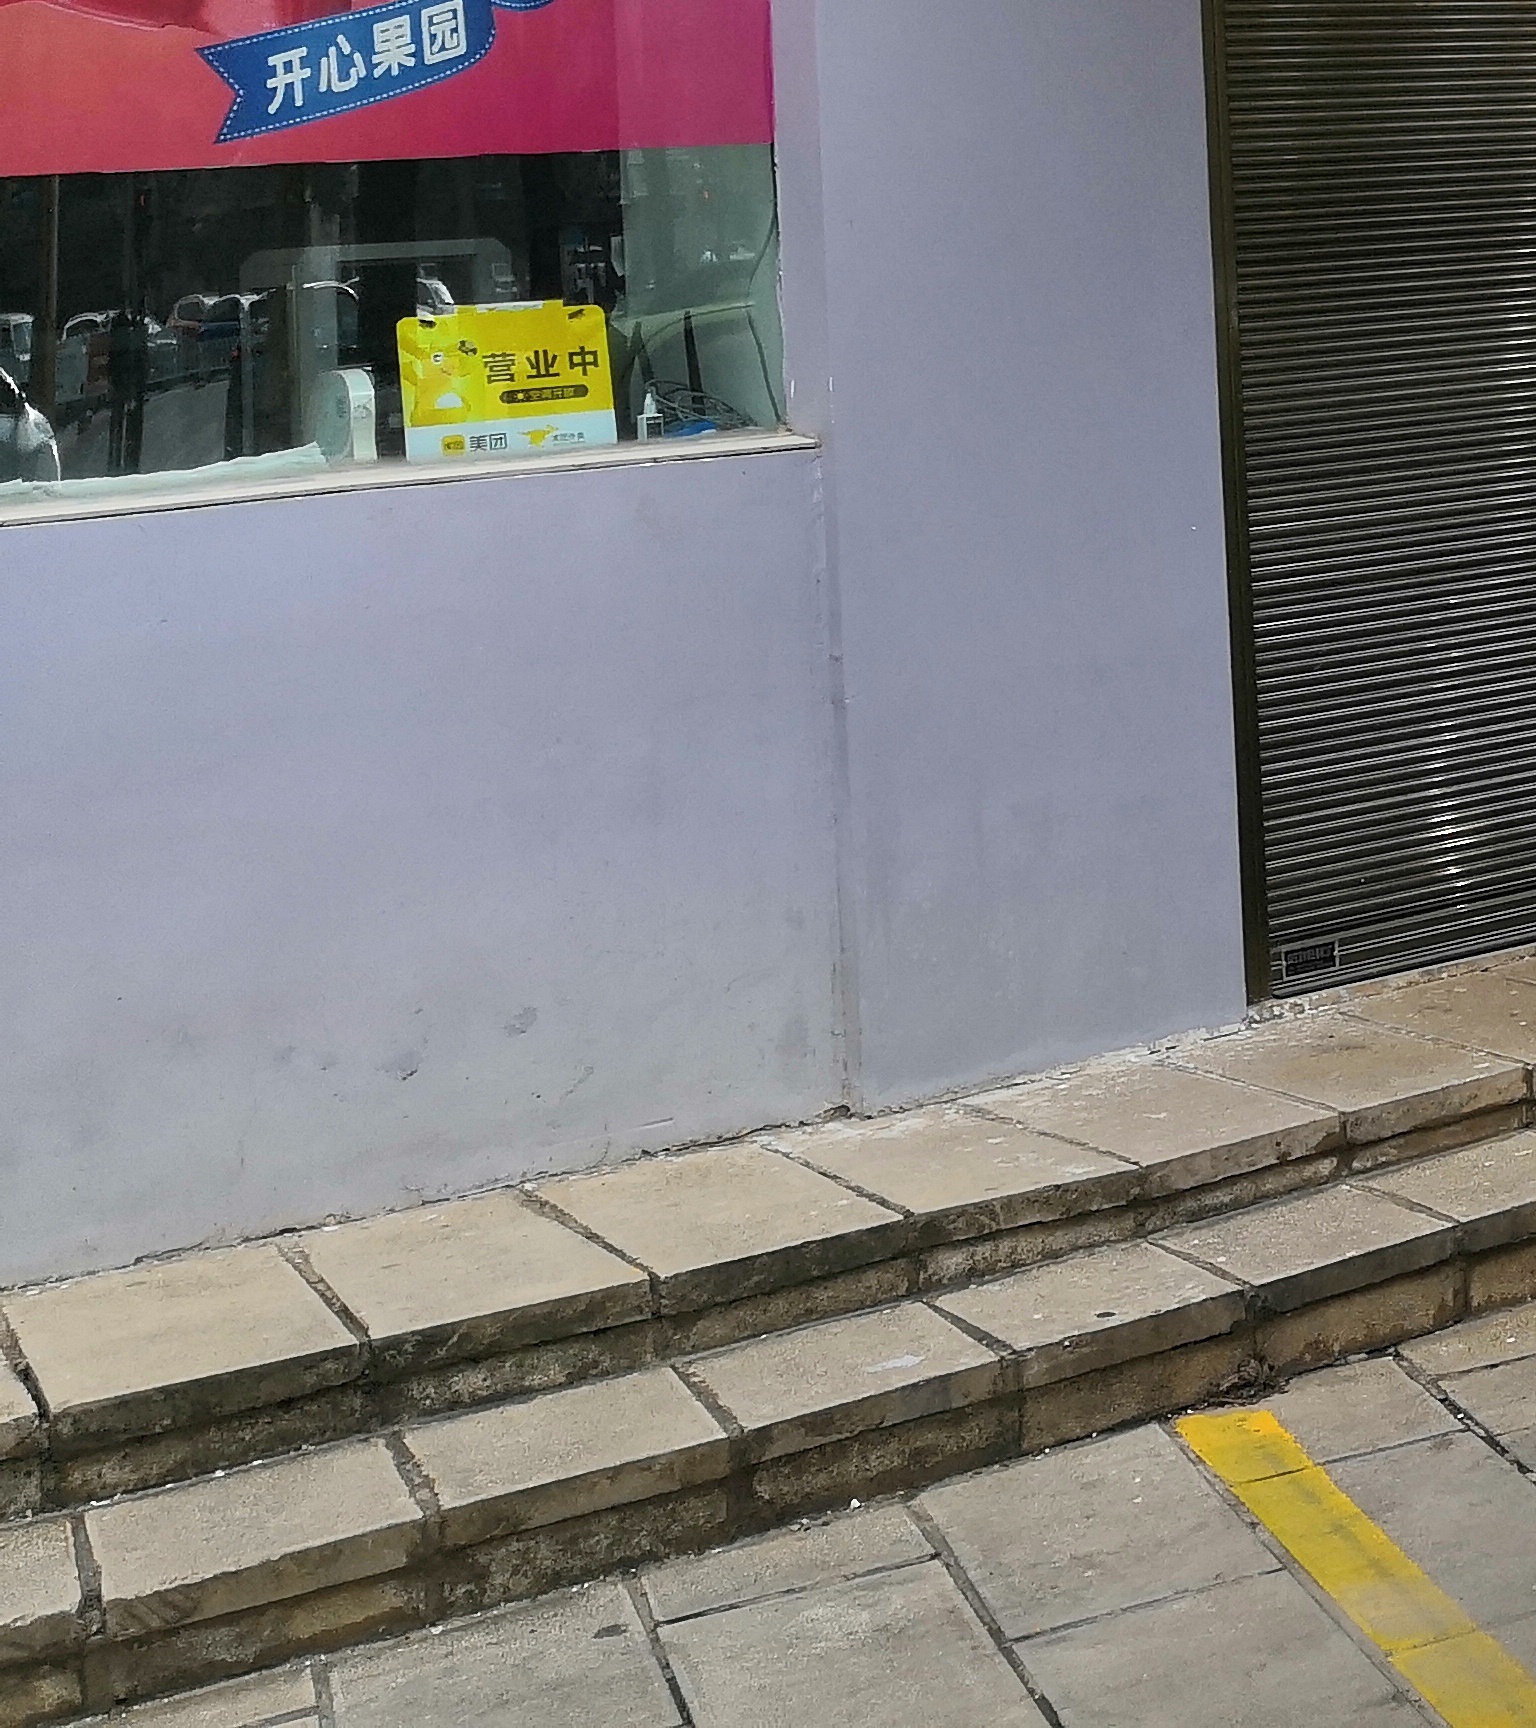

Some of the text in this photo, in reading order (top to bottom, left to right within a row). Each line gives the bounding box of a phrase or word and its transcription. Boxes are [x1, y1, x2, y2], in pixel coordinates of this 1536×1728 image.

[266, 0, 469, 115] 开心果园
[482, 345, 600, 385] 营业中
[469, 432, 508, 452] 美团
